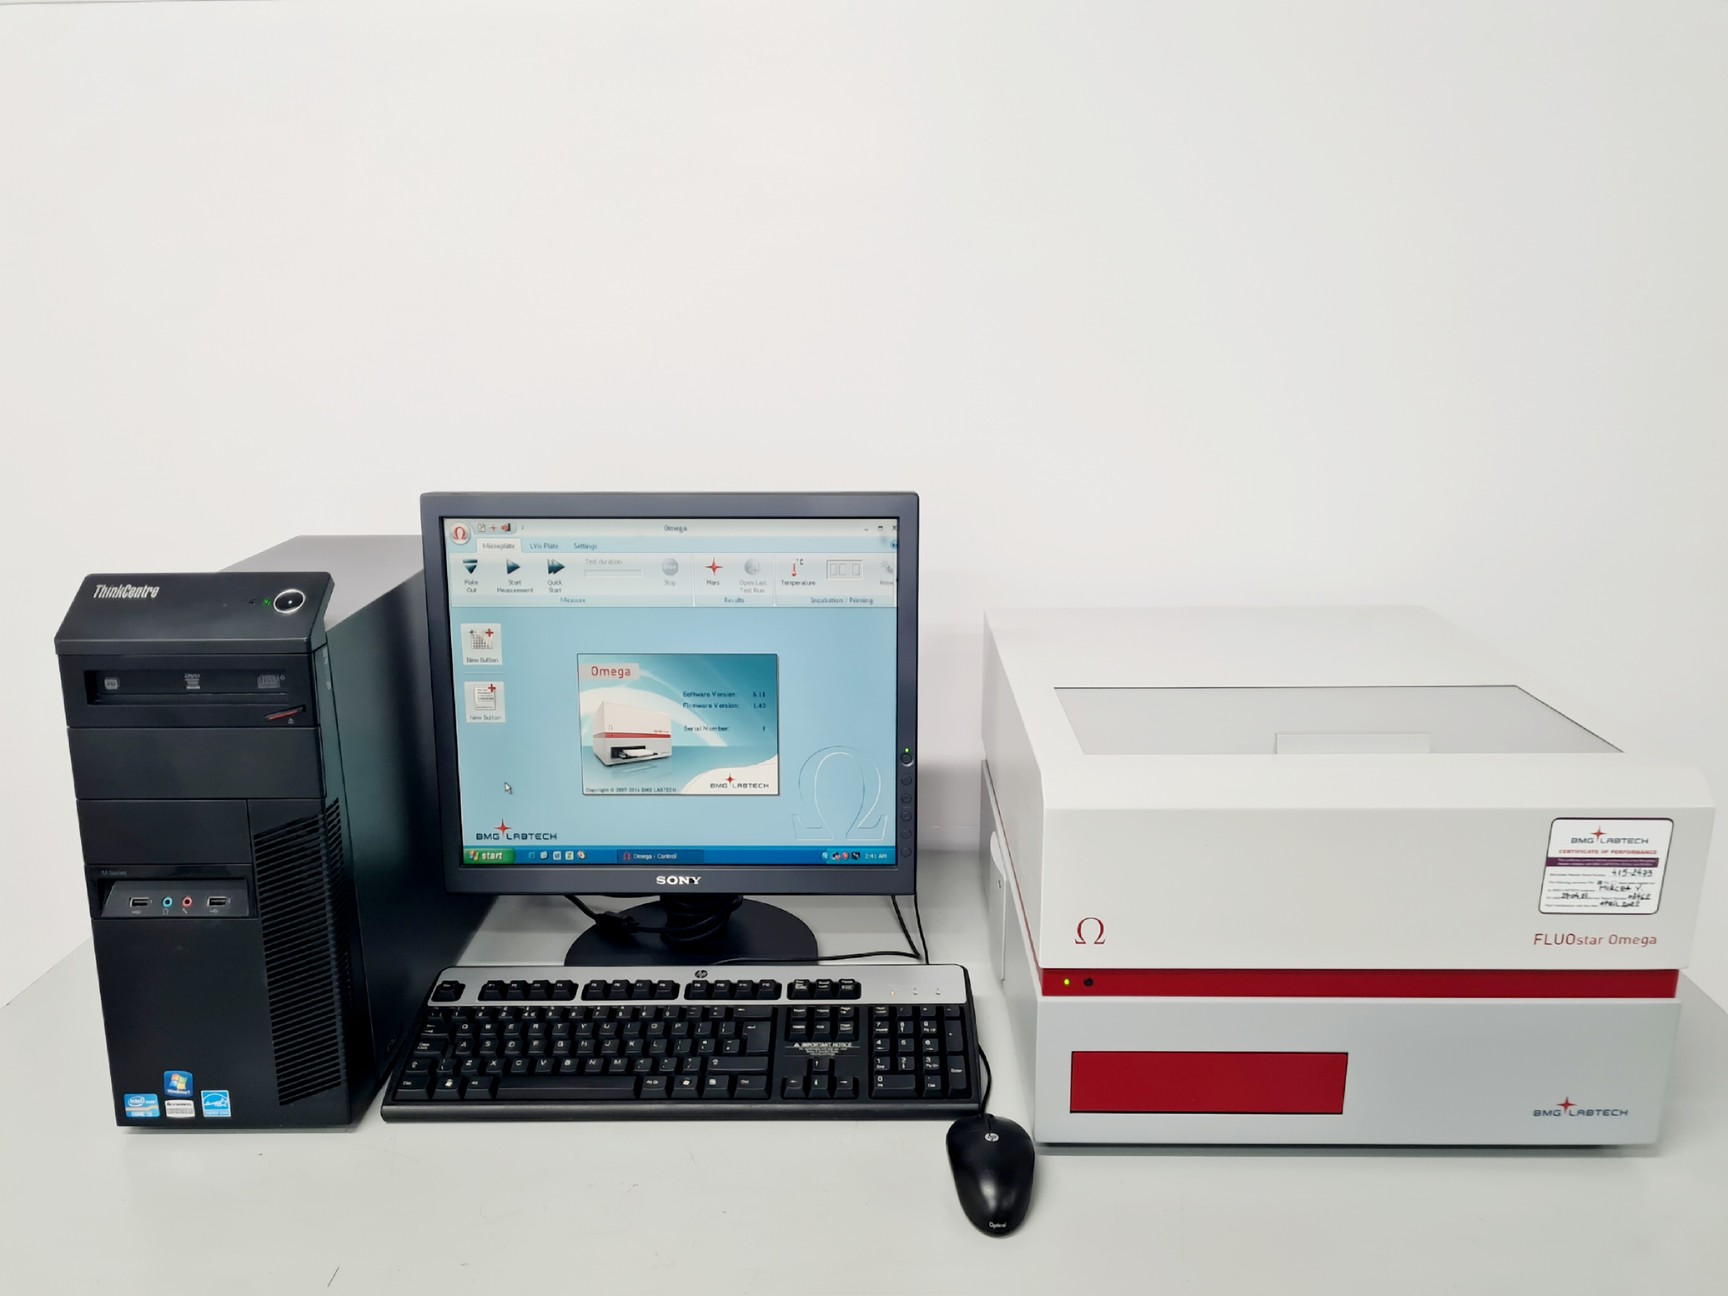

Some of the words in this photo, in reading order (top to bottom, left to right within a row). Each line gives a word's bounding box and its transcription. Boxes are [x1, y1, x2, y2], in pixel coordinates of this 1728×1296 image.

[664, 524, 688, 534] Omega
[482, 542, 516, 550] Microplate
[573, 542, 598, 550] Settings
[93, 584, 160, 599] ThinkCentre
[590, 666, 631, 678] Omega
[476, 832, 500, 840] BMG
[506, 832, 558, 840] LABTECH
[482, 852, 502, 860] start
[656, 876, 702, 885] SONY
[1533, 932, 1604, 946] FLUOstar
[1608, 934, 1658, 948] Omega
